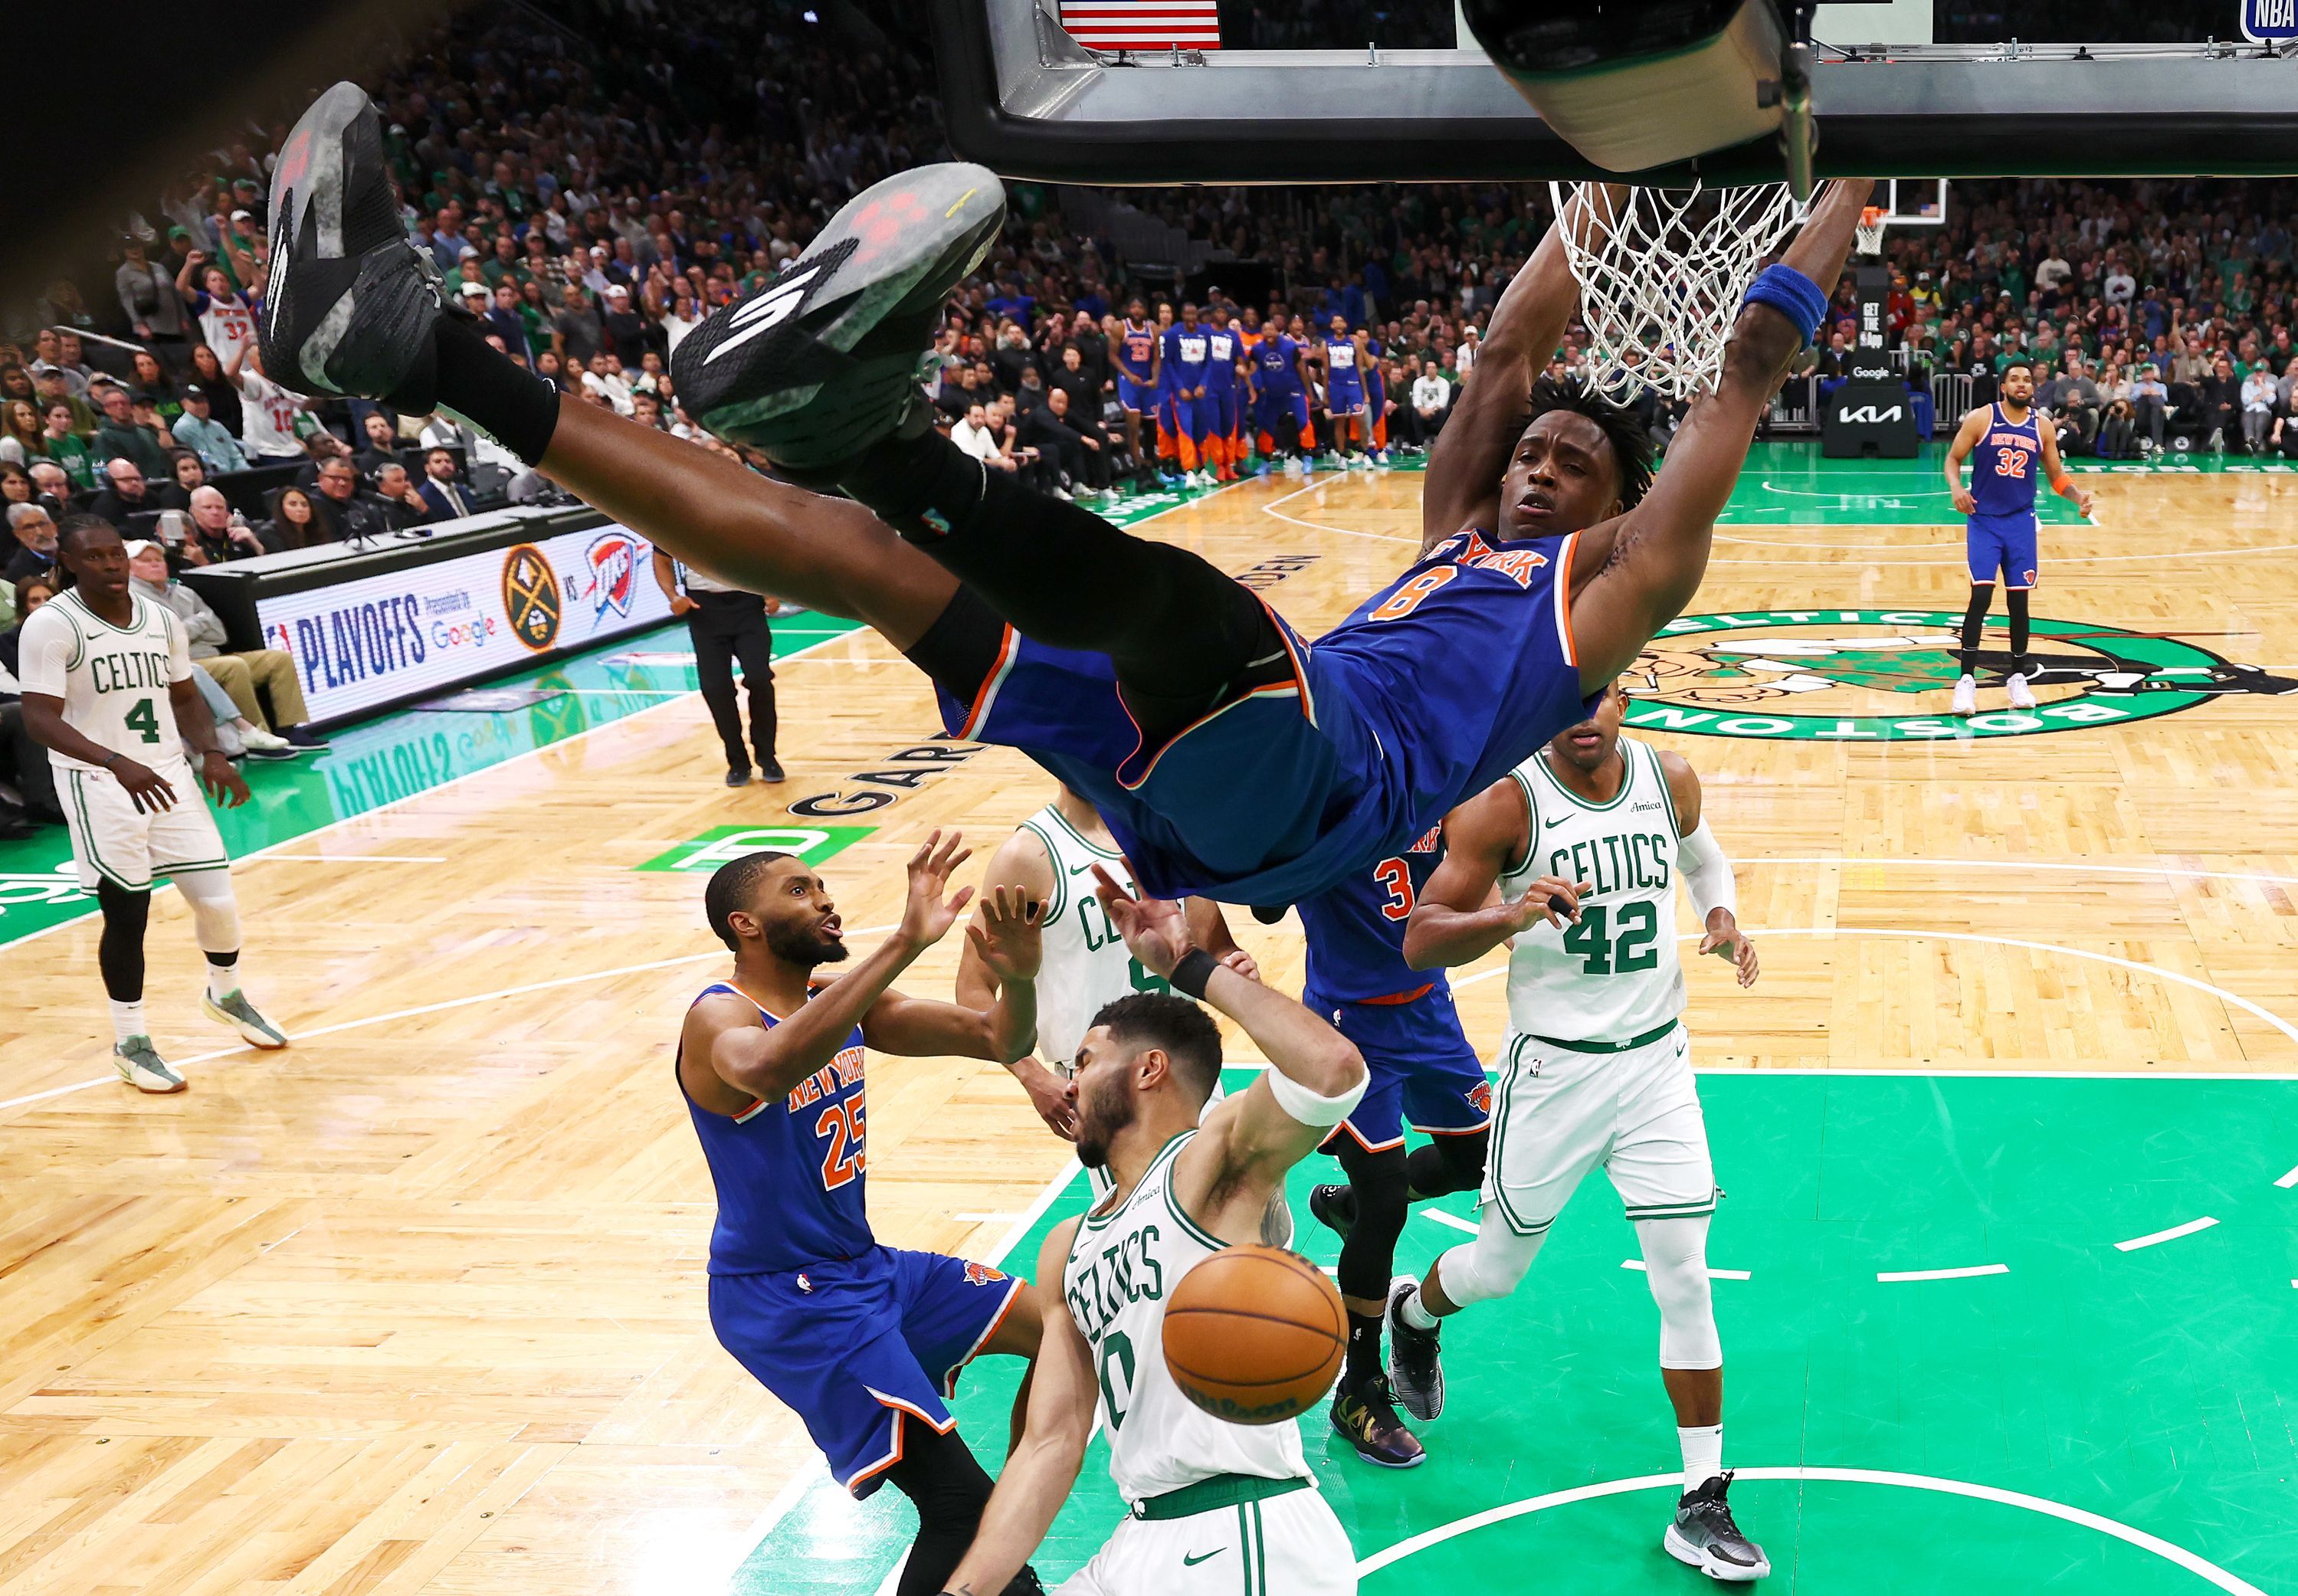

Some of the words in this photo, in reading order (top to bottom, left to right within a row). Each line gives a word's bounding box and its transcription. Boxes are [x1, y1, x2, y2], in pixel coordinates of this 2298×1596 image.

[2254, 0, 2295, 28] NBA
[1863, 303, 1880, 316] GET
[1864, 317, 1880, 331] THE
[1853, 366, 1890, 381] Google
[1995, 447, 2029, 478] 32
[1368, 565, 1458, 622] 8
[297, 593, 426, 693] PLAYOFFS
[431, 610, 496, 649] Google
[124, 698, 160, 744] 4
[1626, 703, 2132, 737] BOSTON
[1631, 800, 1662, 814] Amica
[1374, 856, 1416, 922] 3
[1562, 900, 1657, 975] 42
[788, 1061, 837, 1114] NEW
[815, 1088, 866, 1192] 25
[1132, 1184, 1161, 1211] Amica
[1068, 1224, 1163, 1345] CELTICS
[1100, 1330, 1136, 1431] 0
